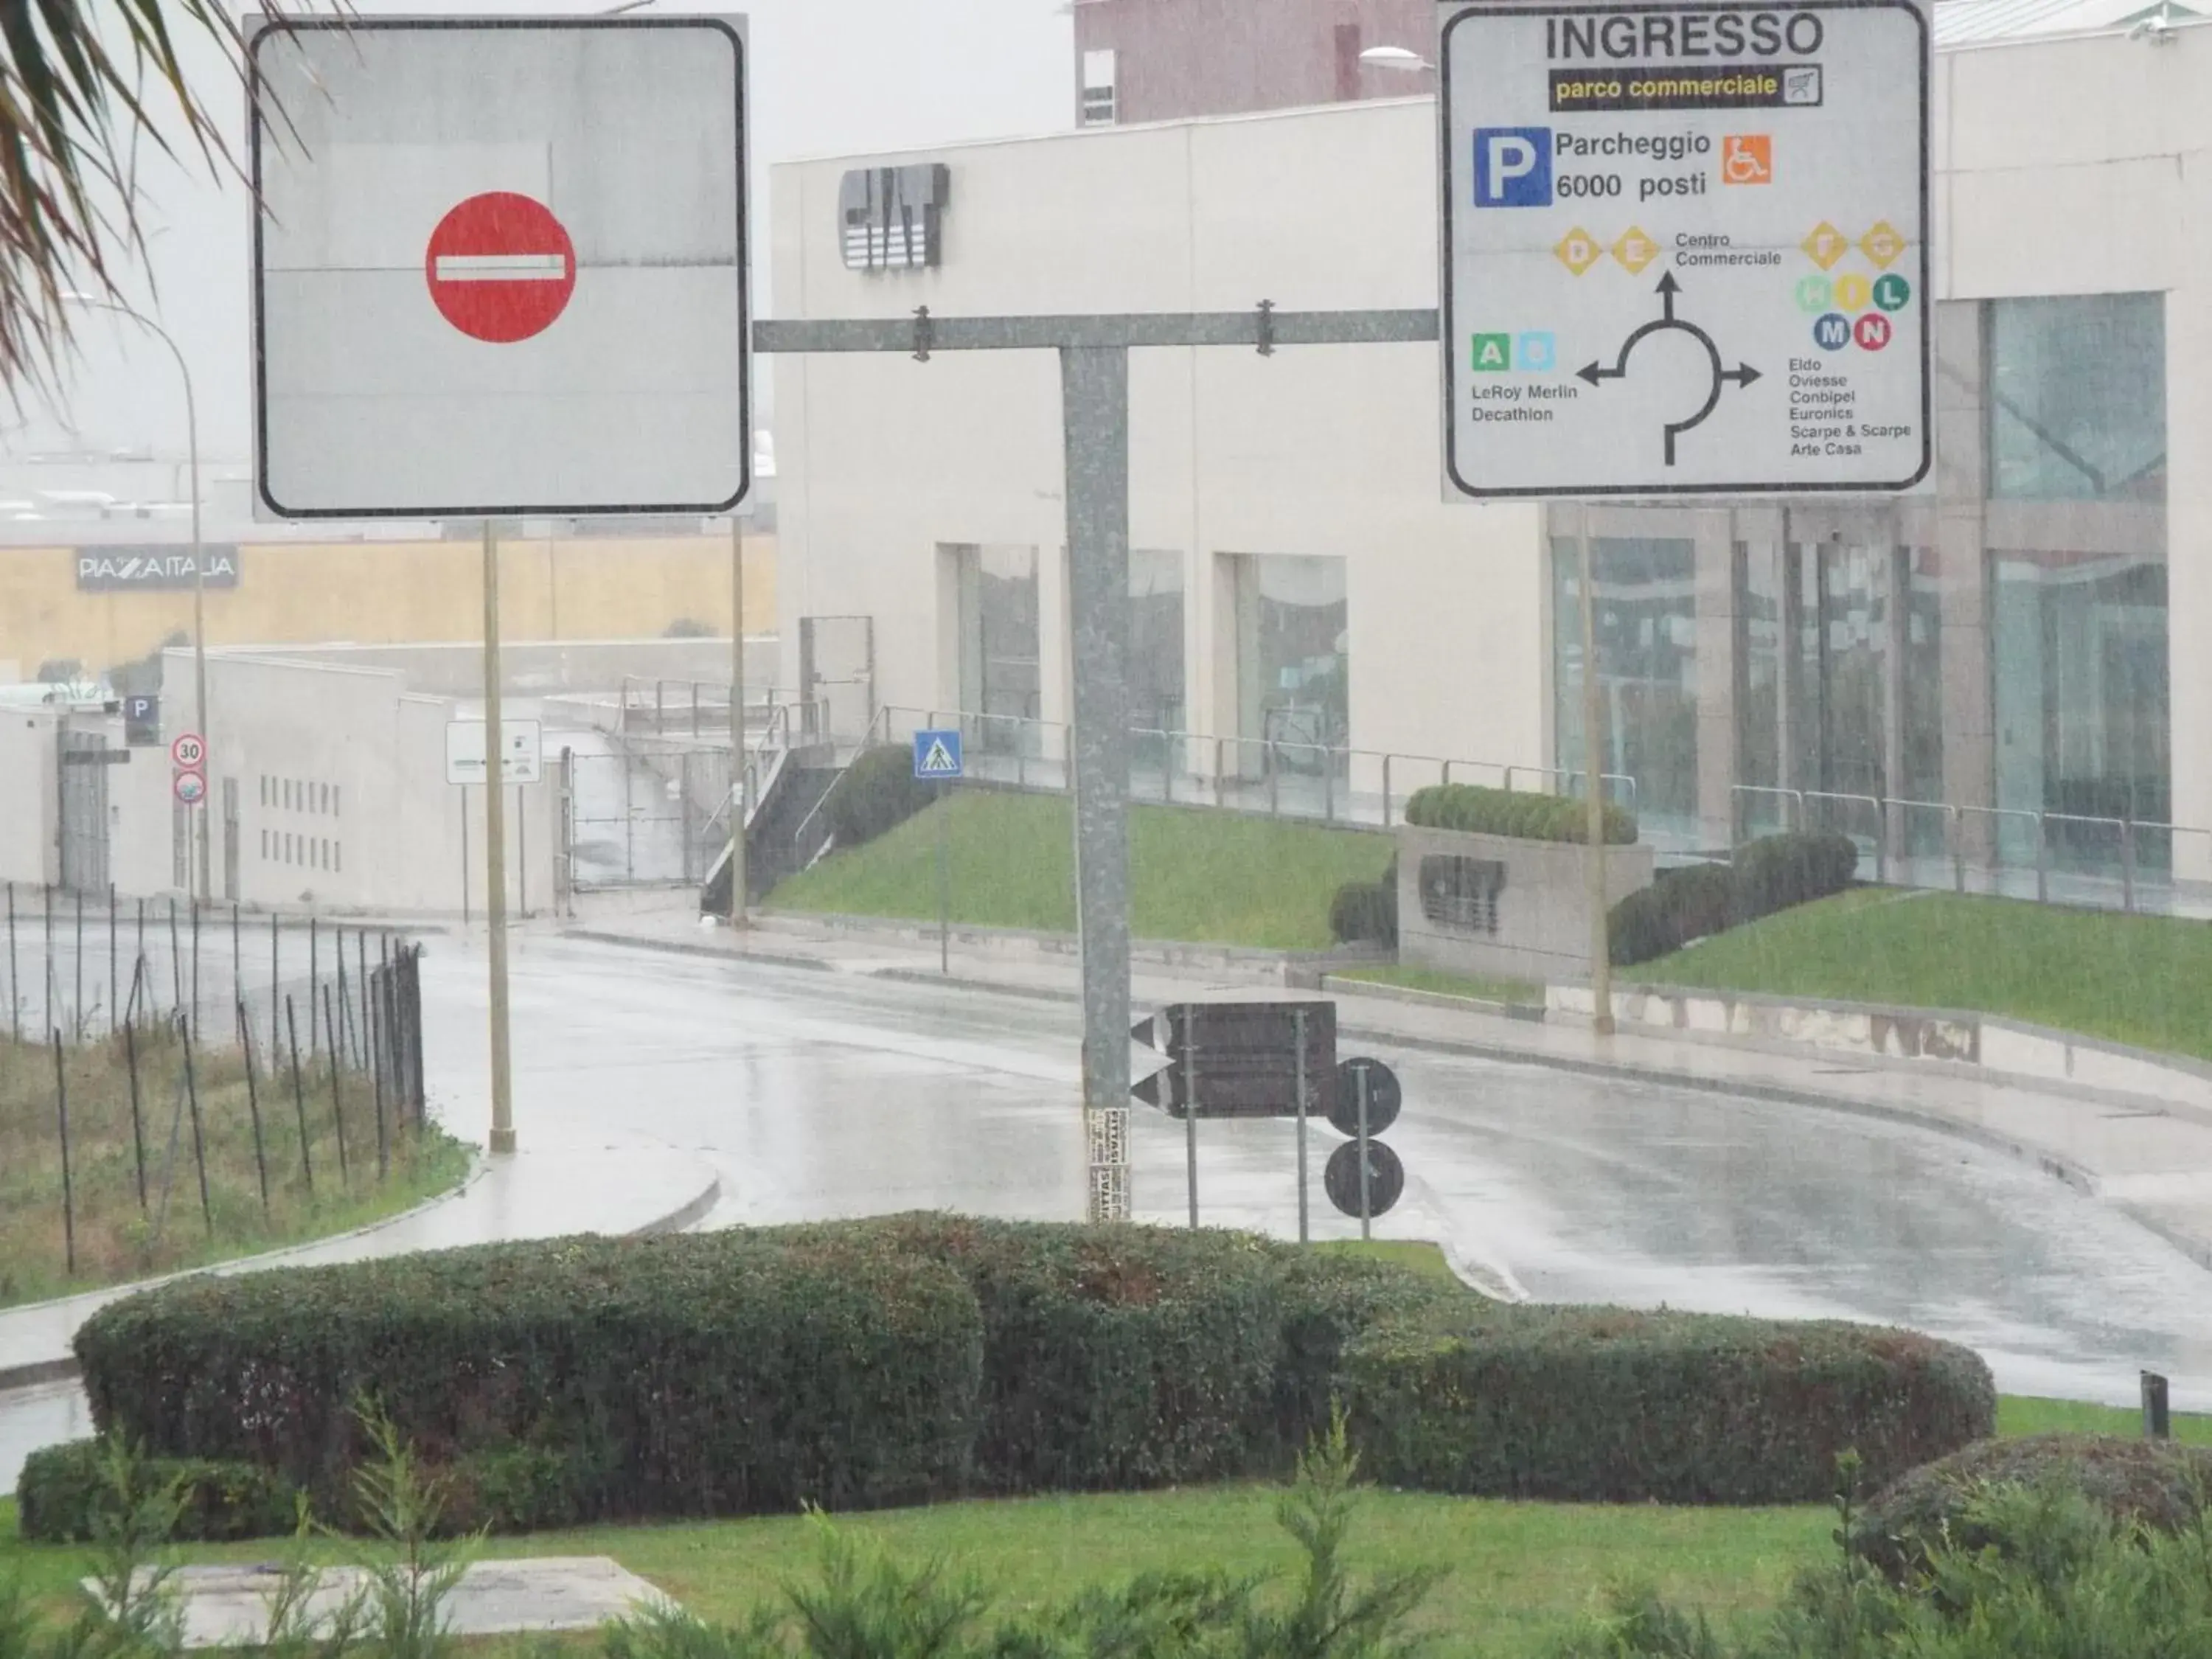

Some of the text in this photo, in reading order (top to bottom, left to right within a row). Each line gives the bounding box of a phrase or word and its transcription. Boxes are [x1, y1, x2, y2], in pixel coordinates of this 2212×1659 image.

[1546, 12, 1823, 59] INGRESSO
[1557, 72, 1778, 102] parco commerciale
[1557, 132, 1711, 161] Parcheggio
[1488, 136, 1537, 200] P
[1557, 173, 1707, 201] 6000 posti
[1676, 233, 1730, 248] Centro
[1676, 251, 1781, 266] Commerciale
[1884, 282, 1901, 304] L
[1822, 321, 1885, 343] M N
[1480, 341, 1503, 364] A
[1789, 358, 1822, 371] Eldo
[1789, 374, 1848, 387] Oviesse
[1472, 384, 1578, 402] LeRoy Merlin
[1472, 406, 1553, 421] Decathlon
[1790, 407, 1853, 420] Euronics
[1790, 424, 1911, 440] Scarpe & Scarpe
[1790, 442, 1863, 456] Arte Casa
[135, 699, 147, 717] P
[181, 743, 198, 759] 30
